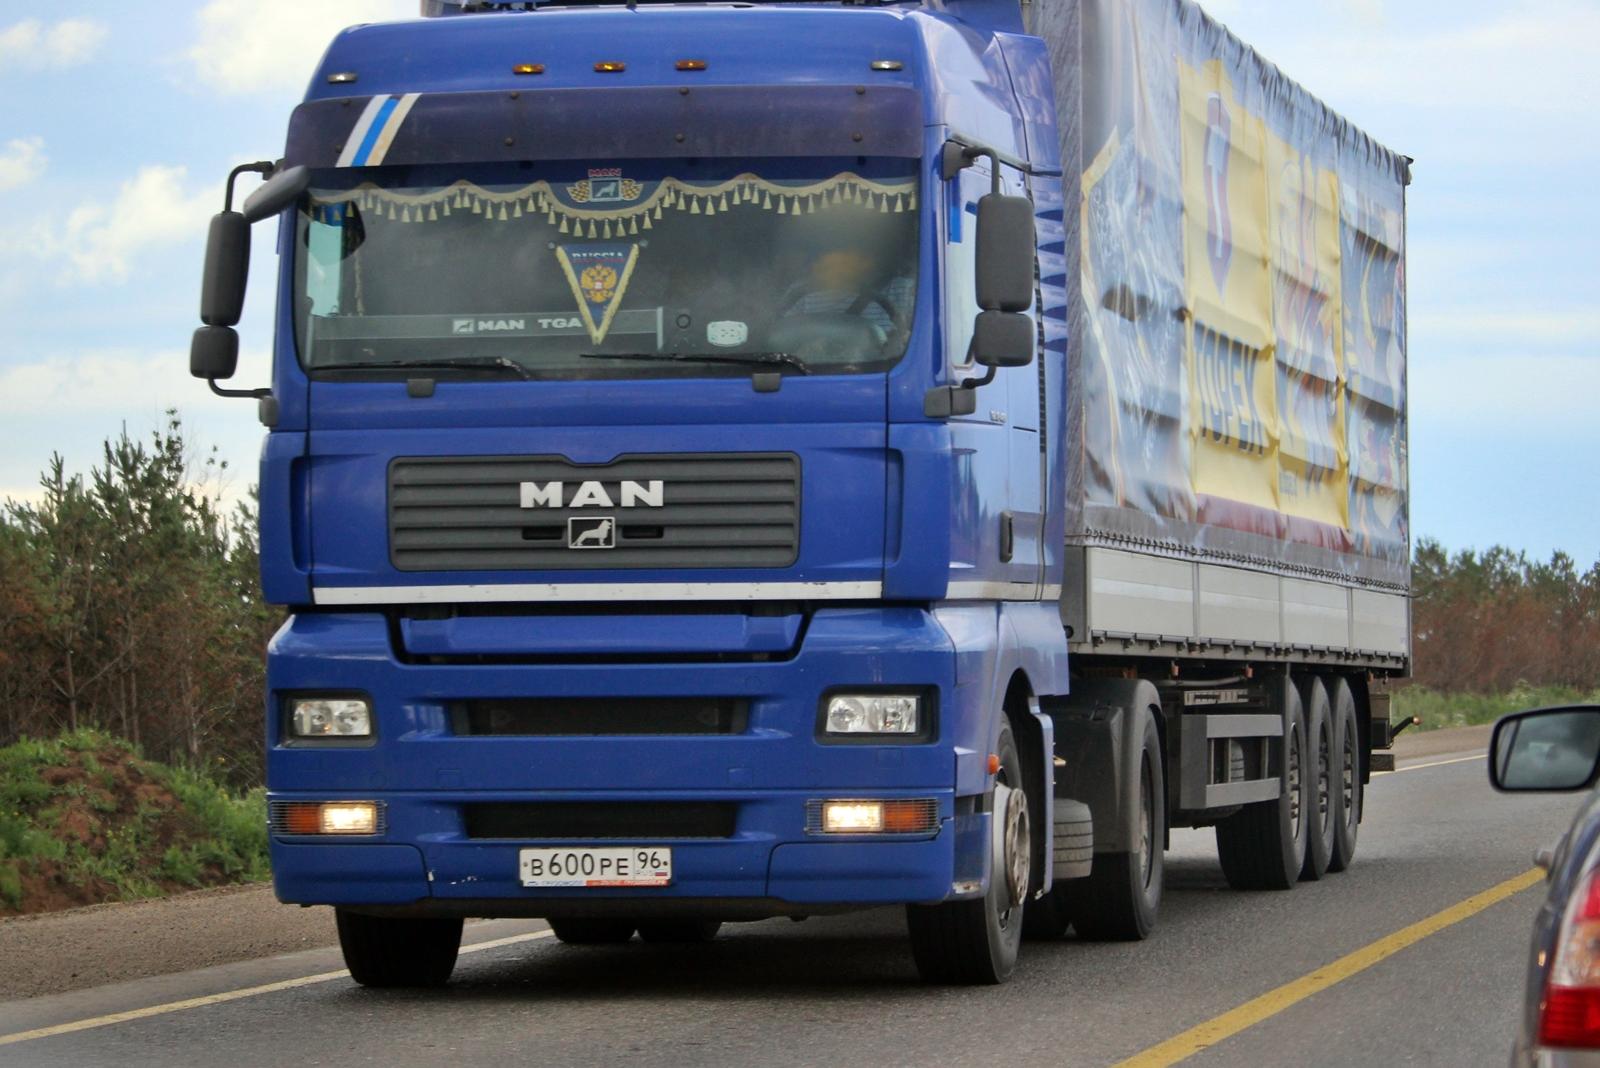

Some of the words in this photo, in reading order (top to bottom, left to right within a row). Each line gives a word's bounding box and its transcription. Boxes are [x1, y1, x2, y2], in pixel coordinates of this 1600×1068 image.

[478, 319, 525, 331] MAN
[538, 317, 582, 329] TGA
[520, 480, 664, 508] MAN
[637, 851, 661, 869] 96
